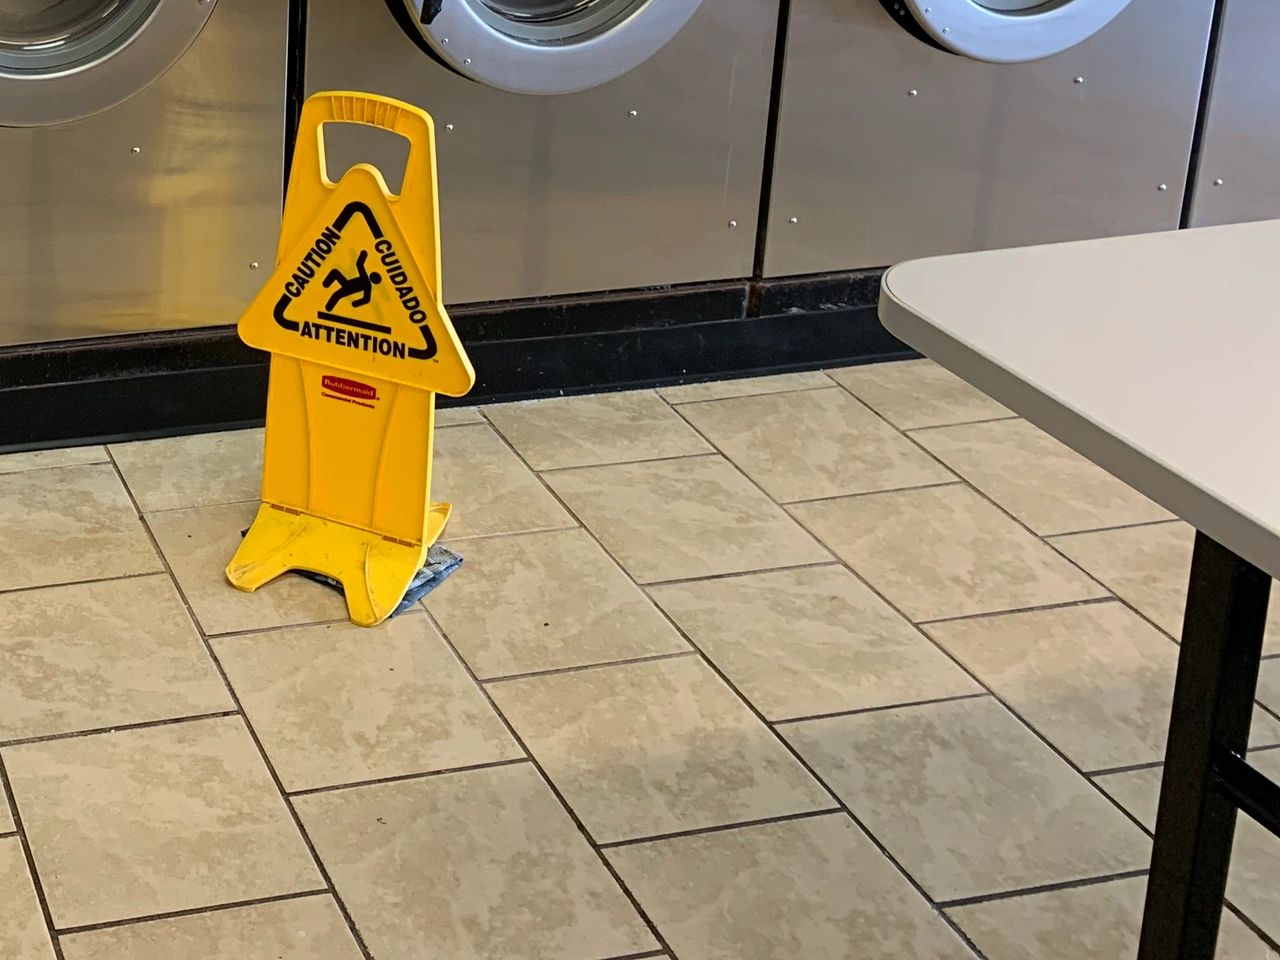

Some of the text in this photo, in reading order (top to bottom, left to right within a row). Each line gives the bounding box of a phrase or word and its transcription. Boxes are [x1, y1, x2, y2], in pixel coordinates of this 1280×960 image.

[284, 226, 342, 298] CAUTION
[374, 239, 427, 325] CUIDADO
[300, 321, 406, 360] ATTENTION
[324, 378, 374, 397] Rubbermaid
